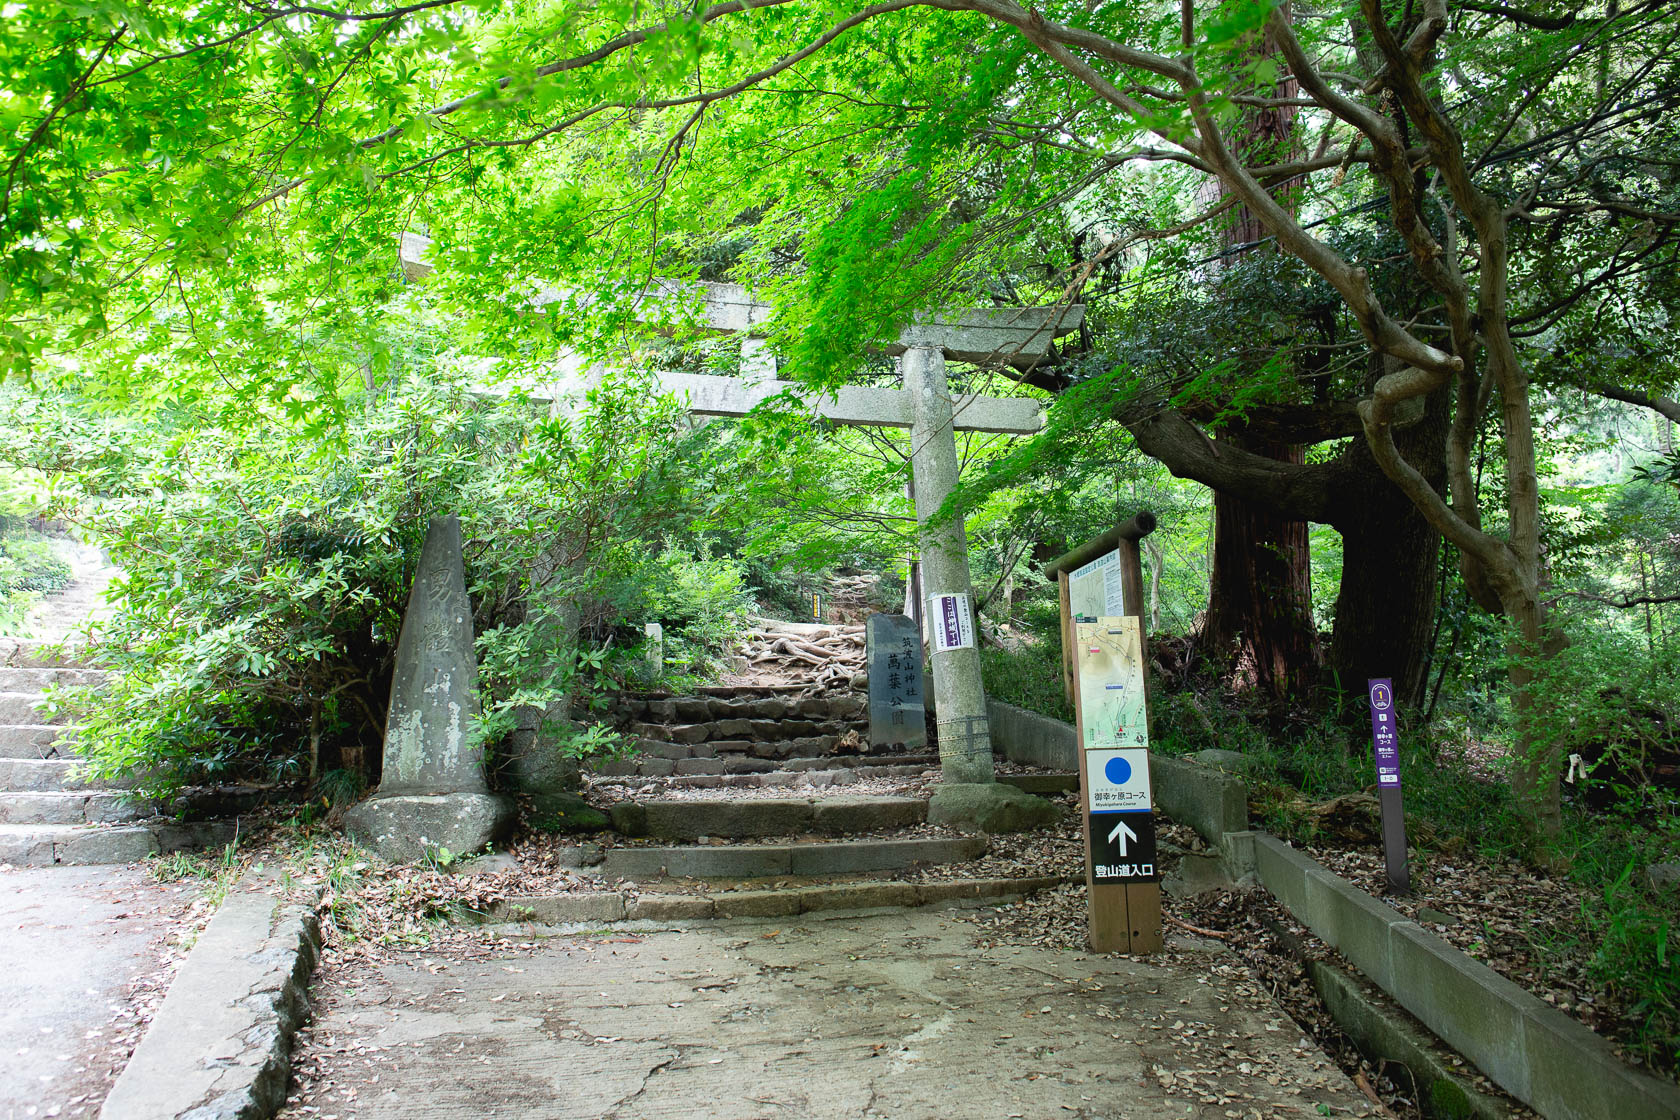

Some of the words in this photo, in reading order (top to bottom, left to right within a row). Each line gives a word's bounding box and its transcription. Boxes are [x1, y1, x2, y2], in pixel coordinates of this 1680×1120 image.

[902, 637, 918, 697] 筑波山神社
[1378, 690, 1383, 700] 1
[1094, 791, 1146, 801] 御幸ヶ原コース
[1095, 863, 1154, 878] 登山道入口
